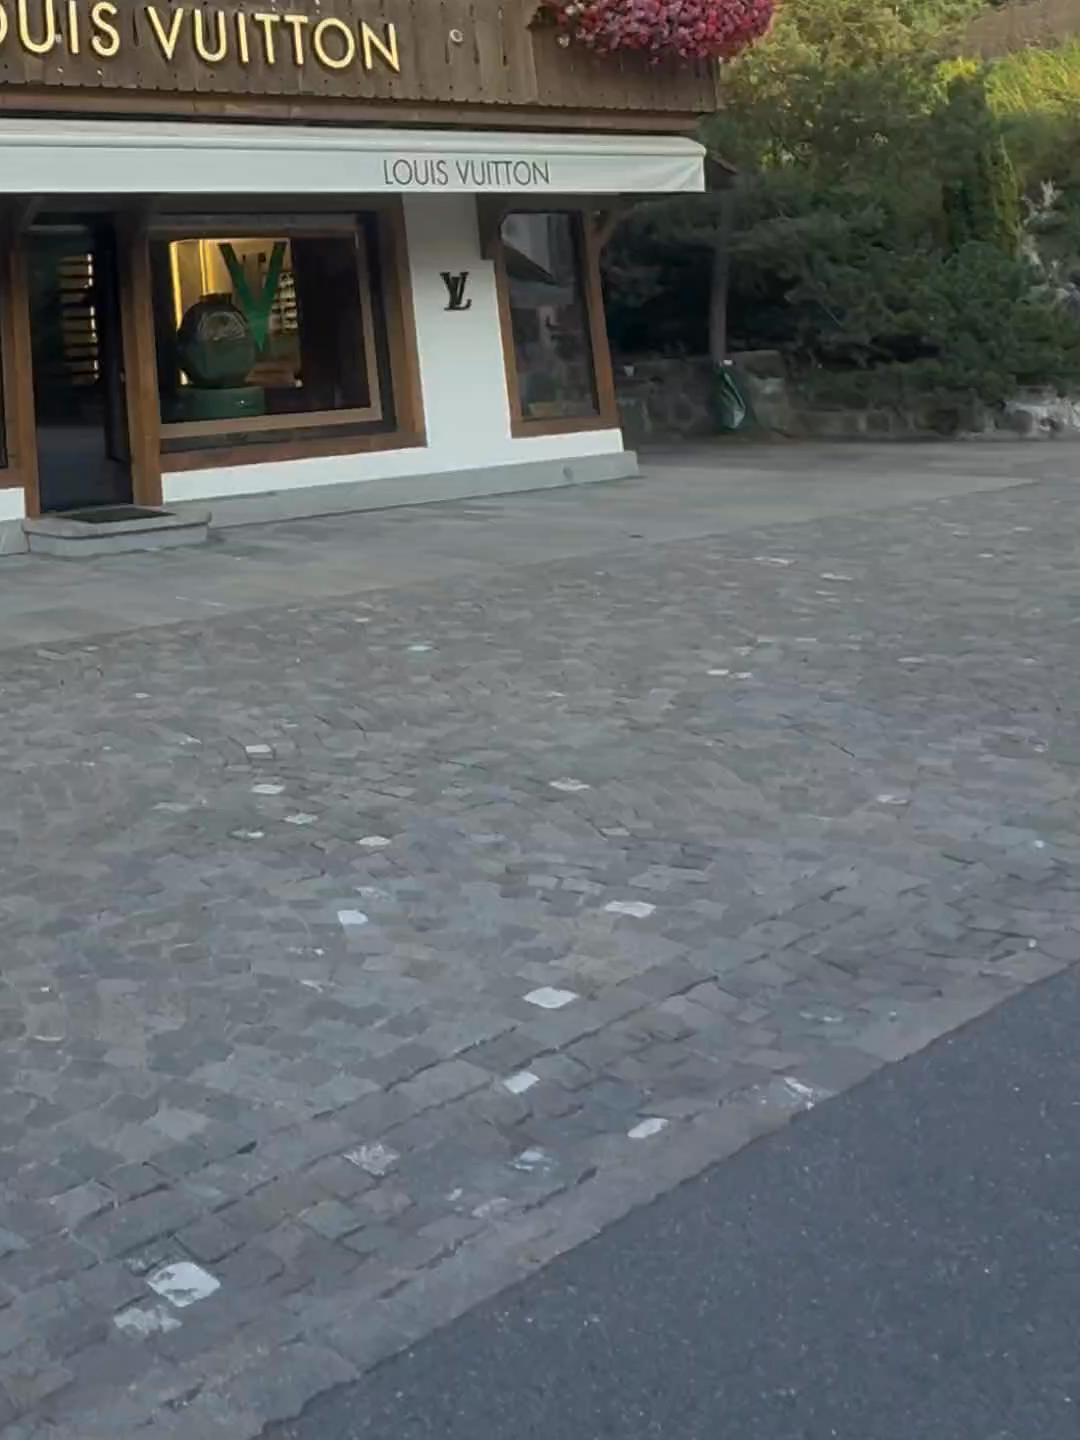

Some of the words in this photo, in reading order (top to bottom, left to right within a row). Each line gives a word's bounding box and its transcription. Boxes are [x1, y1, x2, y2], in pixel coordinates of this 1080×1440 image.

[147, 5, 401, 72] VUITTON
[383, 159, 449, 185] LOUIS
[455, 159, 550, 185] VUITTON
[439, 271, 472, 311] LV
